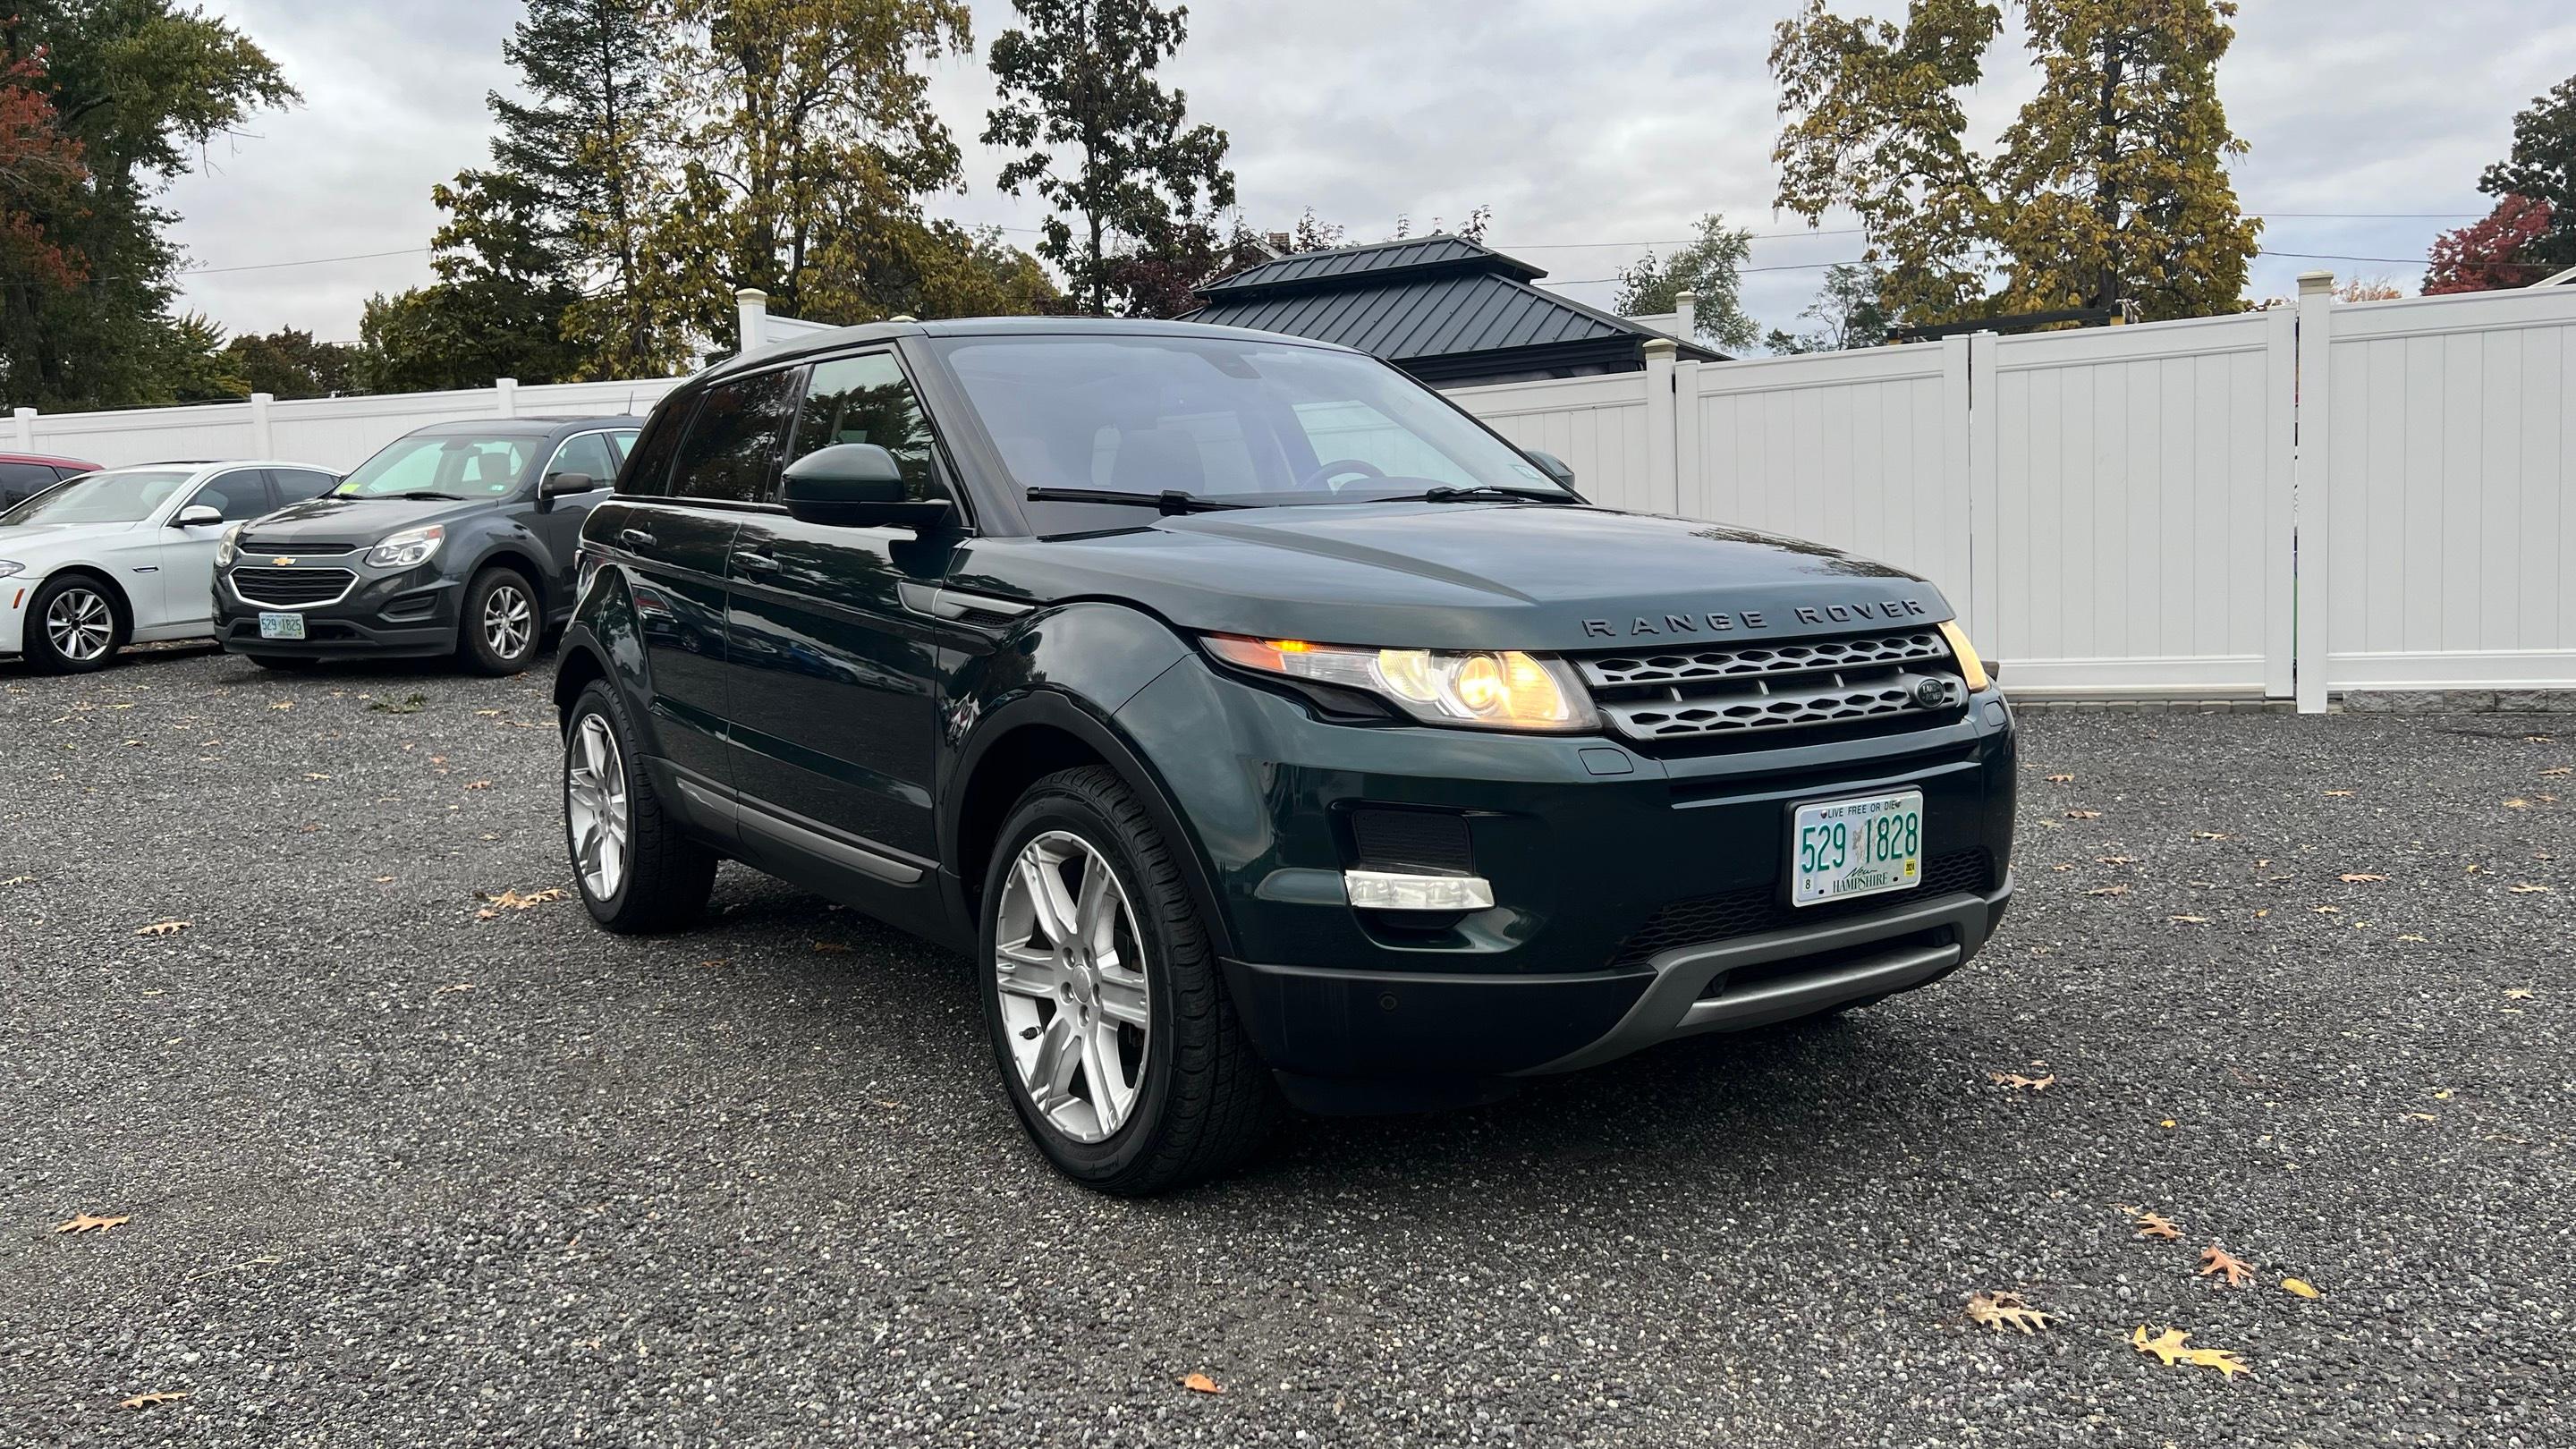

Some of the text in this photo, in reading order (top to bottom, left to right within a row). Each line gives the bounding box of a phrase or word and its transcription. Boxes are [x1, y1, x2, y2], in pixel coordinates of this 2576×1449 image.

[261, 618, 276, 631] 529
[1582, 598, 1926, 638] RANGE ROVER
[1827, 801, 1895, 818] LIVE FREE OR DIE
[1801, 812, 1918, 874] 529 1828
[1844, 866, 1877, 879] New
[1805, 878, 1811, 890] 8
[1834, 872, 1888, 893] HAMPSHIRE
